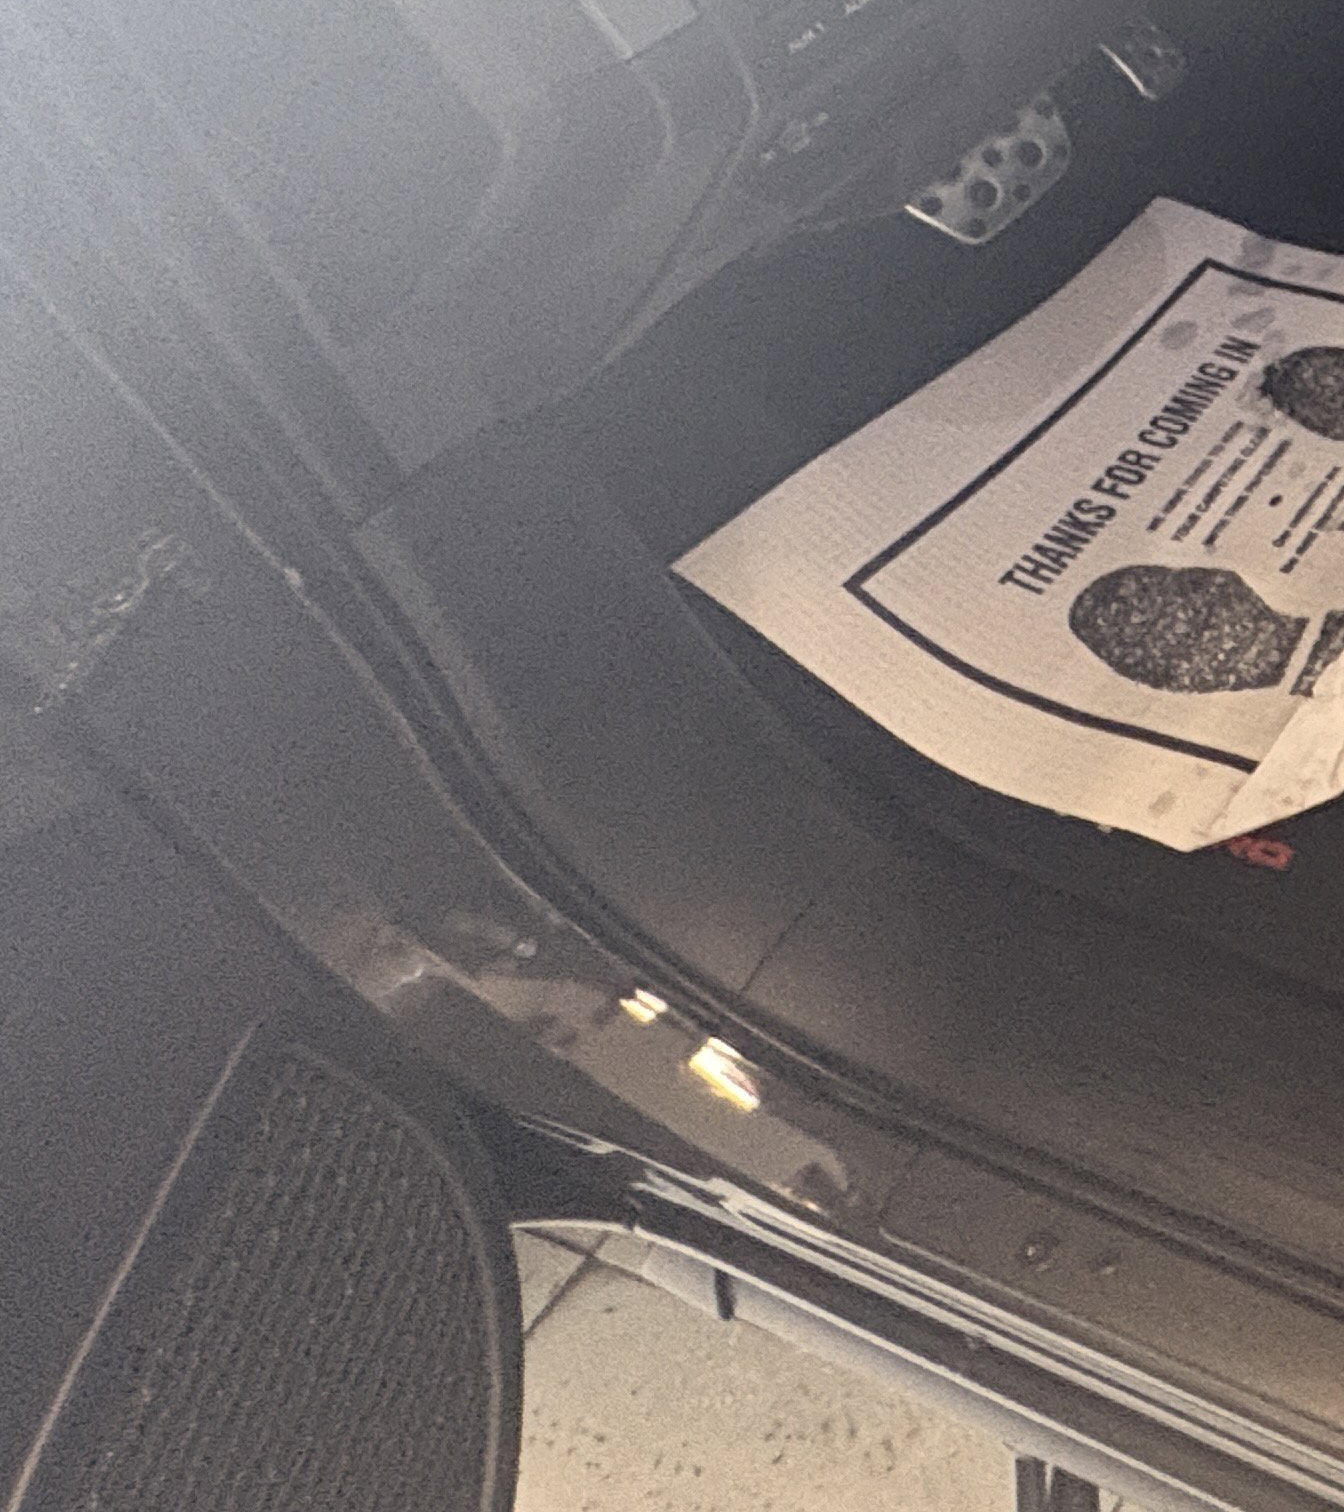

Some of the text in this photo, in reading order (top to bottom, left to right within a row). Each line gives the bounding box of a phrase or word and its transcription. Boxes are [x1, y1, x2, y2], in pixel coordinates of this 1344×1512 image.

[998, 498, 1116, 595] THANKS
[1091, 450, 1162, 500] FOR
[1138, 362, 1239, 449] COMING
[1214, 335, 1261, 364] IN
